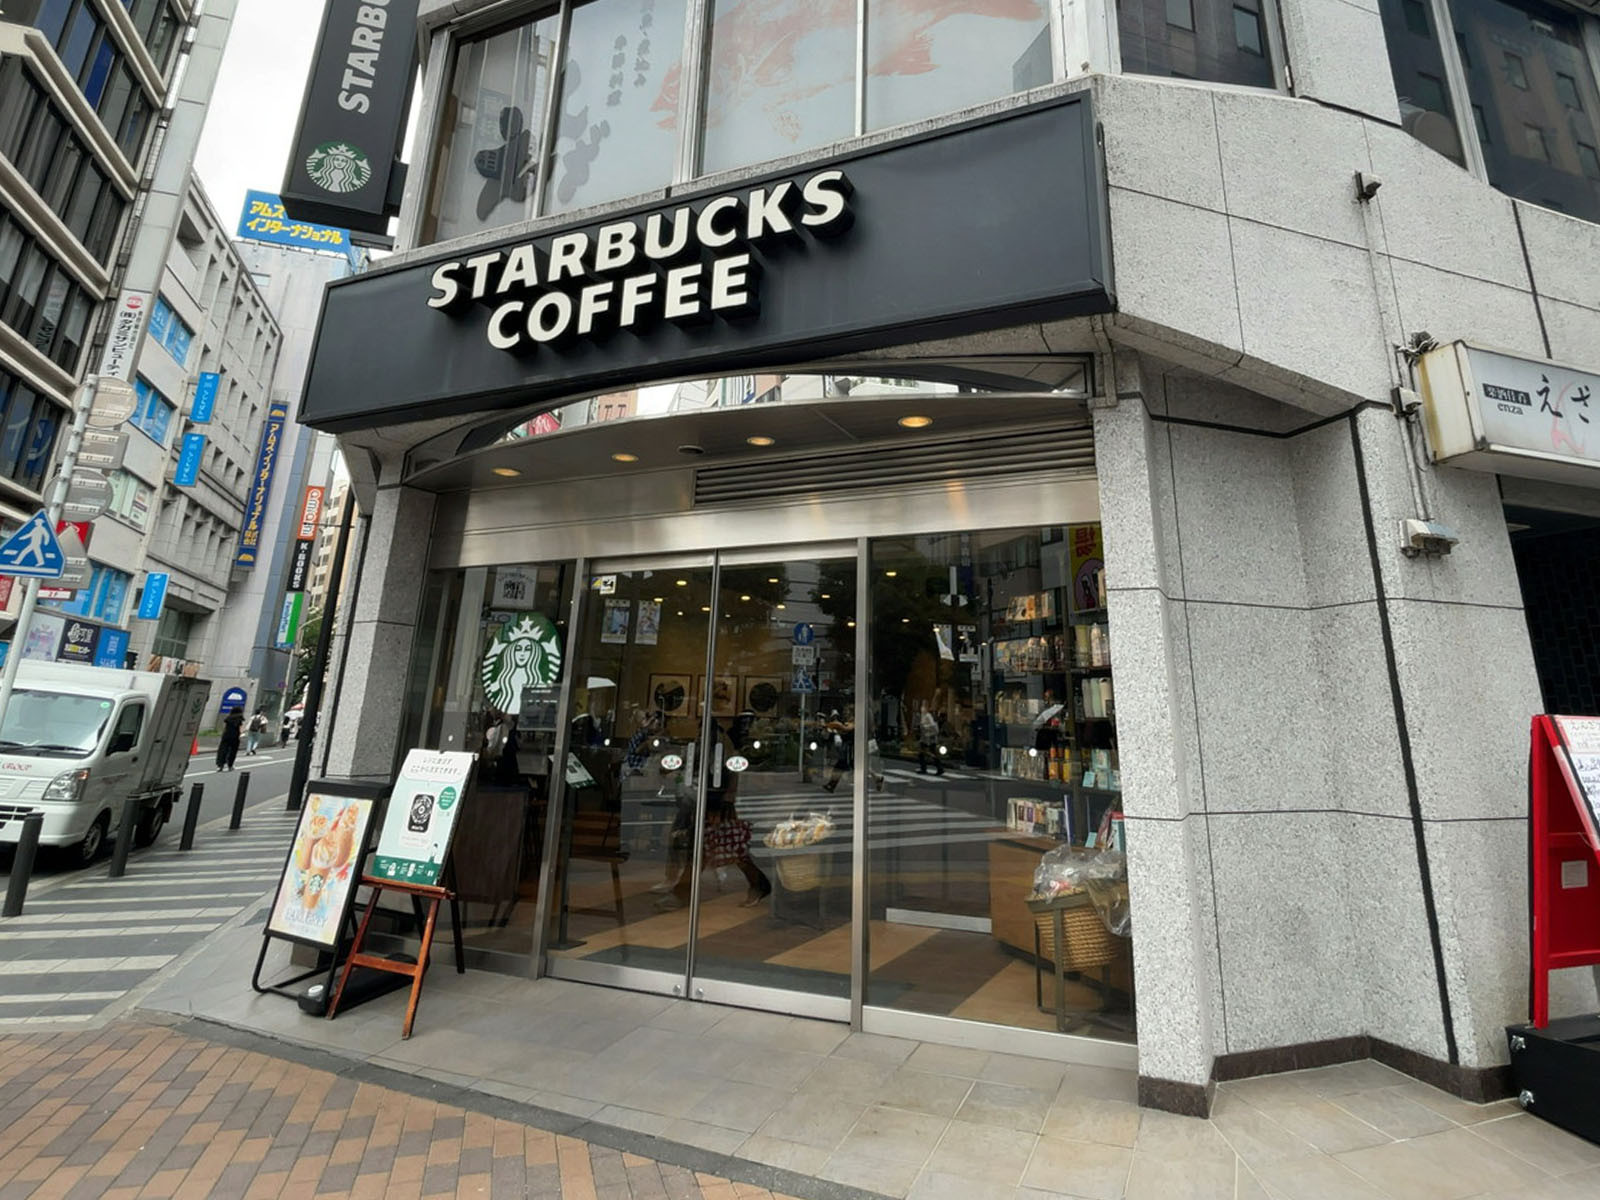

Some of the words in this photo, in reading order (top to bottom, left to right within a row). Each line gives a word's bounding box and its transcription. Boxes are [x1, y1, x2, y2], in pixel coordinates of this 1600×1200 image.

[338, 0, 391, 115] STARB
[246, 217, 343, 245] インターナショナル
[427, 170, 844, 309] STARBUCKS
[486, 253, 751, 350] COFFEE
[1497, 402, 1524, 416] enza
